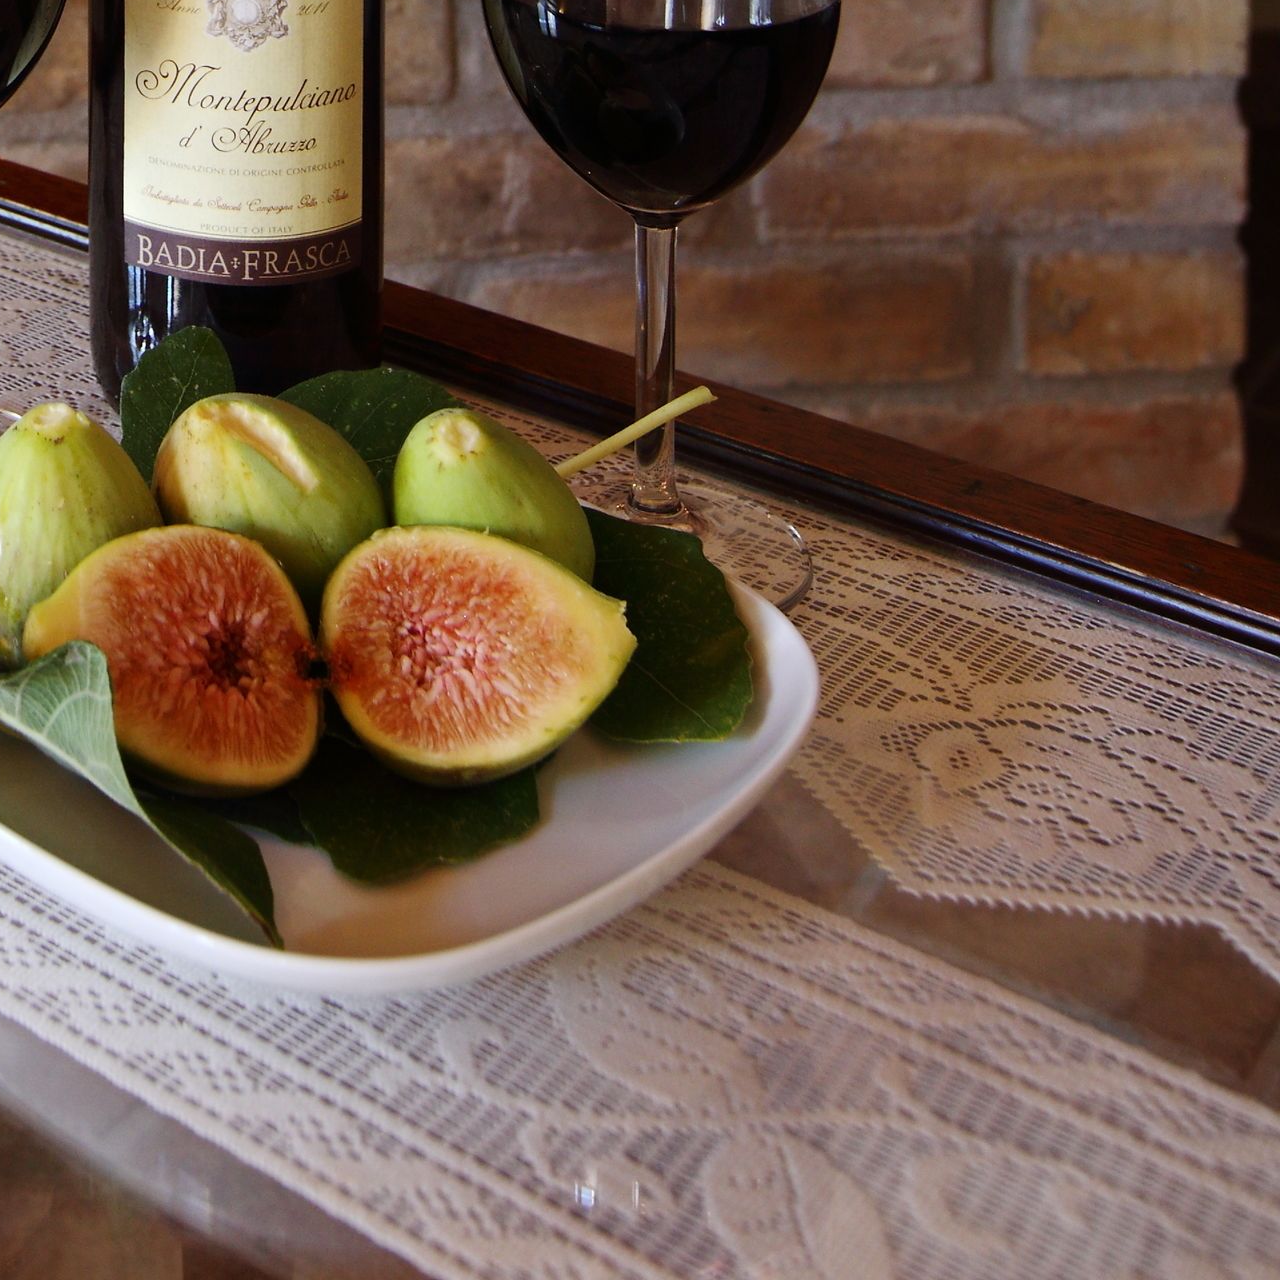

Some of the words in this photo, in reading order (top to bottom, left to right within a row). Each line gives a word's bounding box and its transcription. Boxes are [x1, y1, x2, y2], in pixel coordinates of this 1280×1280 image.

[296, 0, 330, 16] 2011
[135, 59, 357, 126] Montepulciano
[212, 120, 317, 154] Abruzzo
[148, 156, 225, 176] DENOMINAZIONE
[229, 167, 240, 177] DI
[243, 167, 282, 177] ORIGINE
[286, 159, 346, 176] CONTROLLATA
[200, 223, 248, 234] PRODUCT
[252, 225, 264, 234] OF
[269, 224, 294, 234] ITALY
[137, 234, 231, 274] BADIA
[241, 240, 352, 280] FRASCA
